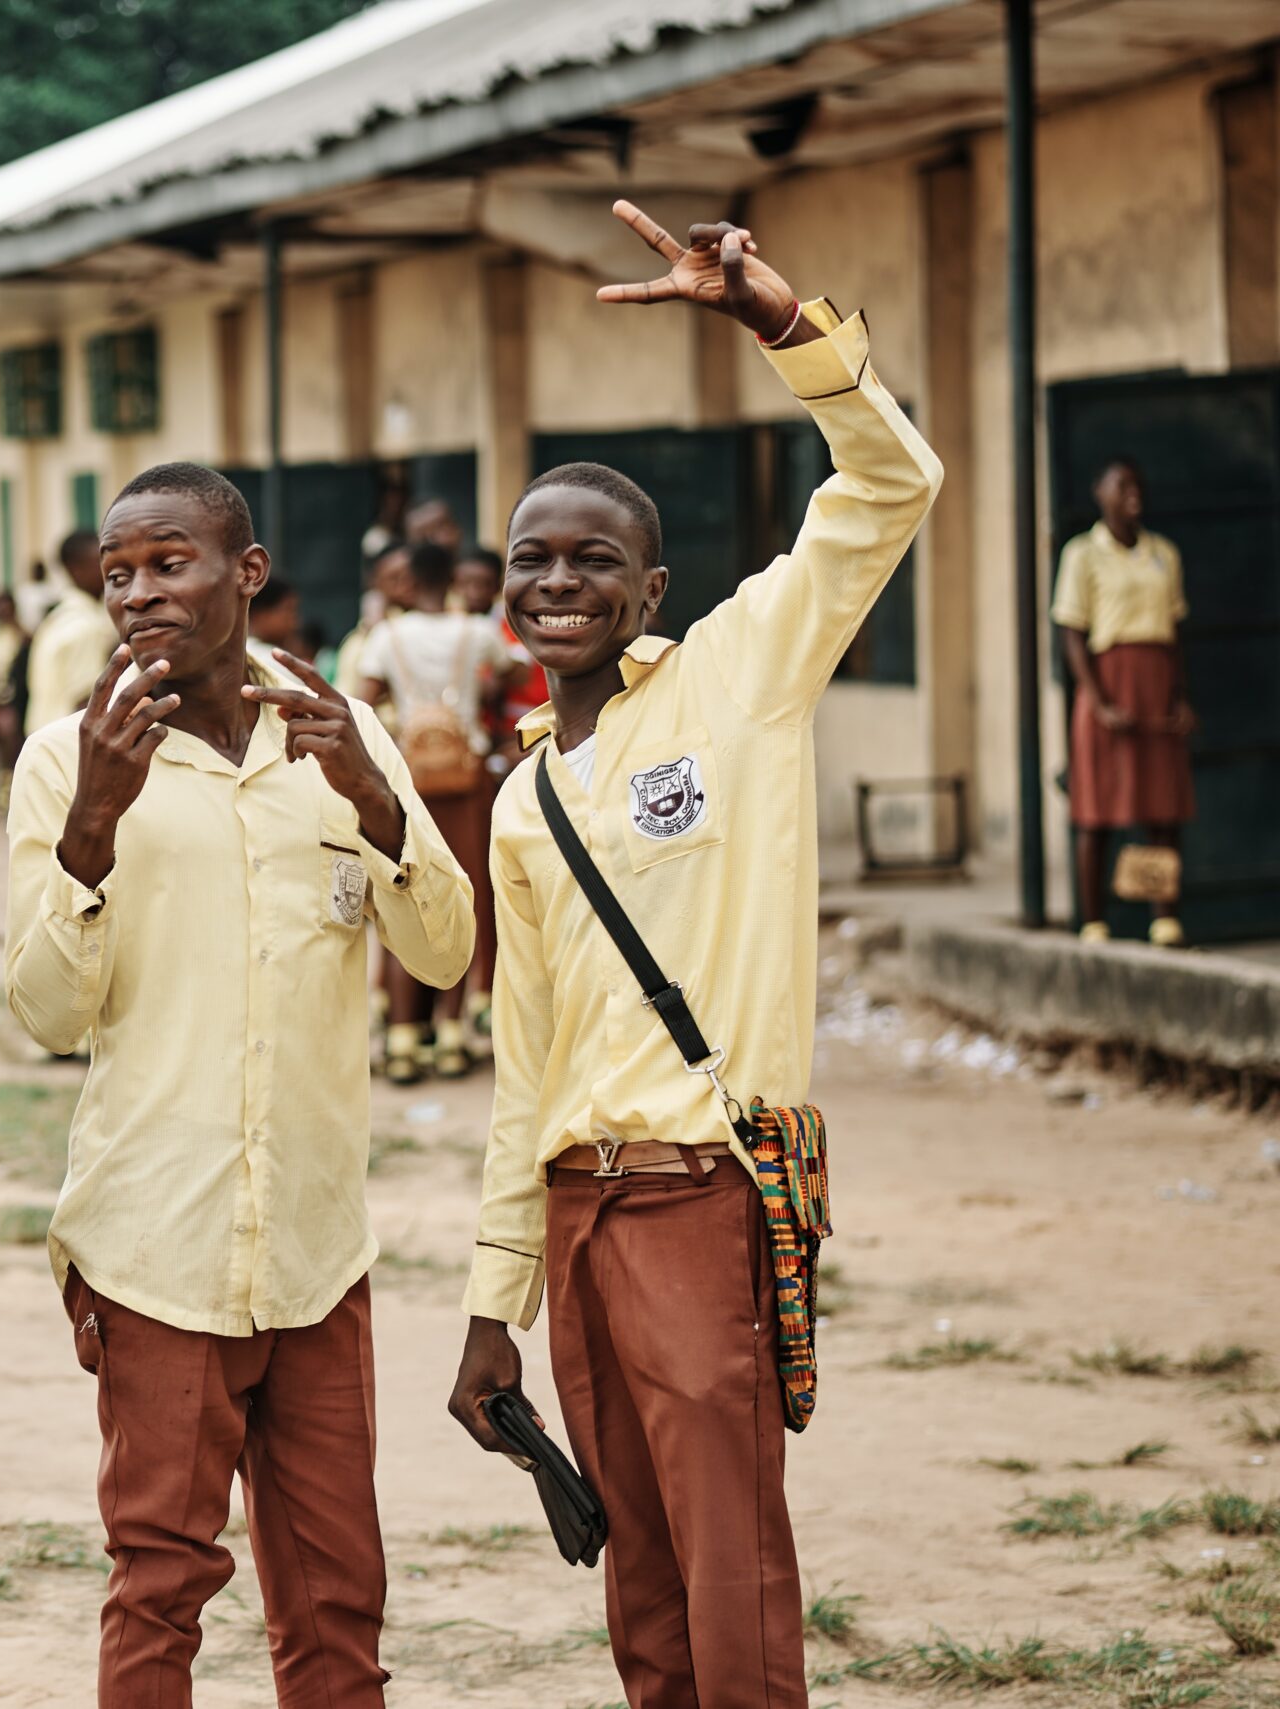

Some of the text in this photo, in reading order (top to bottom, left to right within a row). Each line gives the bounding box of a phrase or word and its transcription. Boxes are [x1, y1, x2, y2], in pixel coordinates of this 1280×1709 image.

[644, 766, 678, 781] OGINIGBA
[645, 813, 661, 826] SEC.
[682, 773, 694, 814] OGINIGBA
[641, 821, 675, 835] EDUCATION
[682, 809, 697, 827] LIGHT
